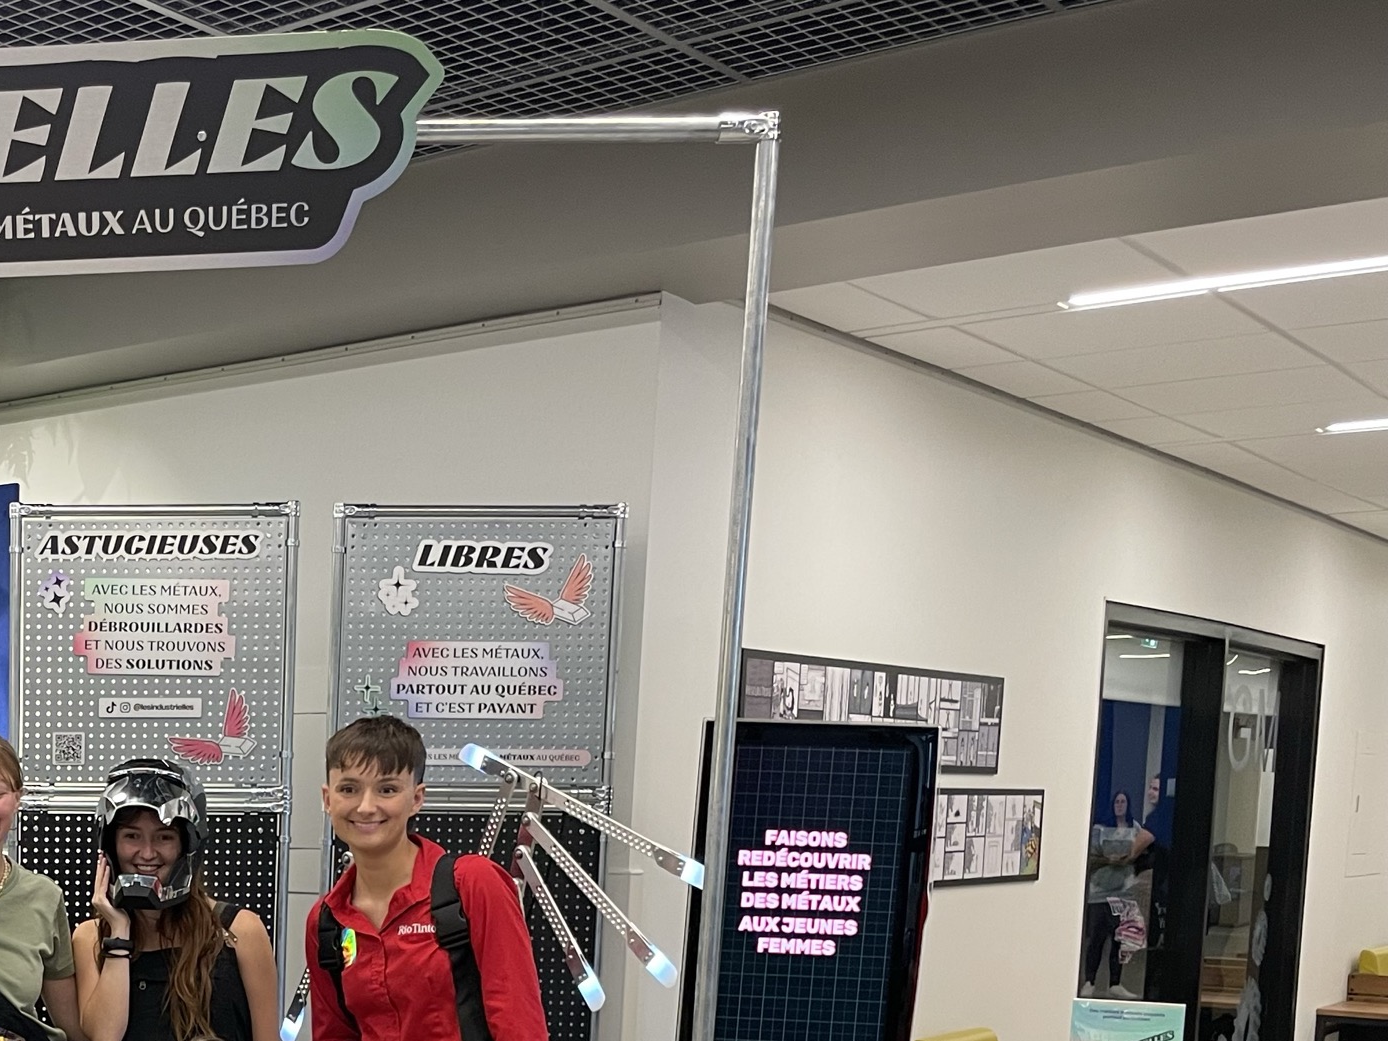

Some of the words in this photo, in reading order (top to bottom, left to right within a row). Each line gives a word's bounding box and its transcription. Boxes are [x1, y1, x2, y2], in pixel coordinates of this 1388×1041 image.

[132, 208, 174, 235] AU
[183, 199, 310, 237] QUÉBEC
[39, 534, 260, 556] ASTUCIEUSES
[417, 544, 549, 570] LIBRES
[92, 584, 128, 596] AVEC
[132, 584, 157, 596] LES
[160, 582, 222, 598] MÉTAUX,
[103, 603, 144, 614] NOUS
[147, 603, 209, 616] SOMMES
[88, 618, 224, 634] DÉBROUILLARDES
[84, 639, 101, 651] ET
[104, 640, 144, 651] NOUS
[147, 640, 226, 653] TROUVONS
[412, 647, 449, 659] AVEC
[453, 647, 478, 659] LES
[481, 644, 544, 660] MÉTAUX,
[95, 658, 122, 669] DES
[125, 658, 214, 671] SOLUTIONS
[407, 665, 448, 677] NOUS
[450, 665, 548, 678] TRAVAILLONS
[396, 684, 466, 696] PARTOUT
[470, 684, 492, 696] AU
[495, 681, 558, 698] QUÉBEC
[133, 703, 194, 713] @lesindustrielles
[415, 702, 432, 713] ET
[435, 702, 475, 714] C'EST
[478, 702, 537, 714] PAYANT
[548, 753, 580, 762] QUÉBEC
[765, 829, 848, 848] FAISONS
[738, 848, 872, 871] REDÉCOUVRIR
[741, 871, 778, 889] LES
[780, 870, 863, 892] MÉTIERS
[740, 891, 778, 910] DES
[780, 890, 862, 913] MÉTAUX
[738, 915, 780, 933] AUX
[781, 916, 858, 936] JEUNES
[757, 936, 836, 956] FEMMES
